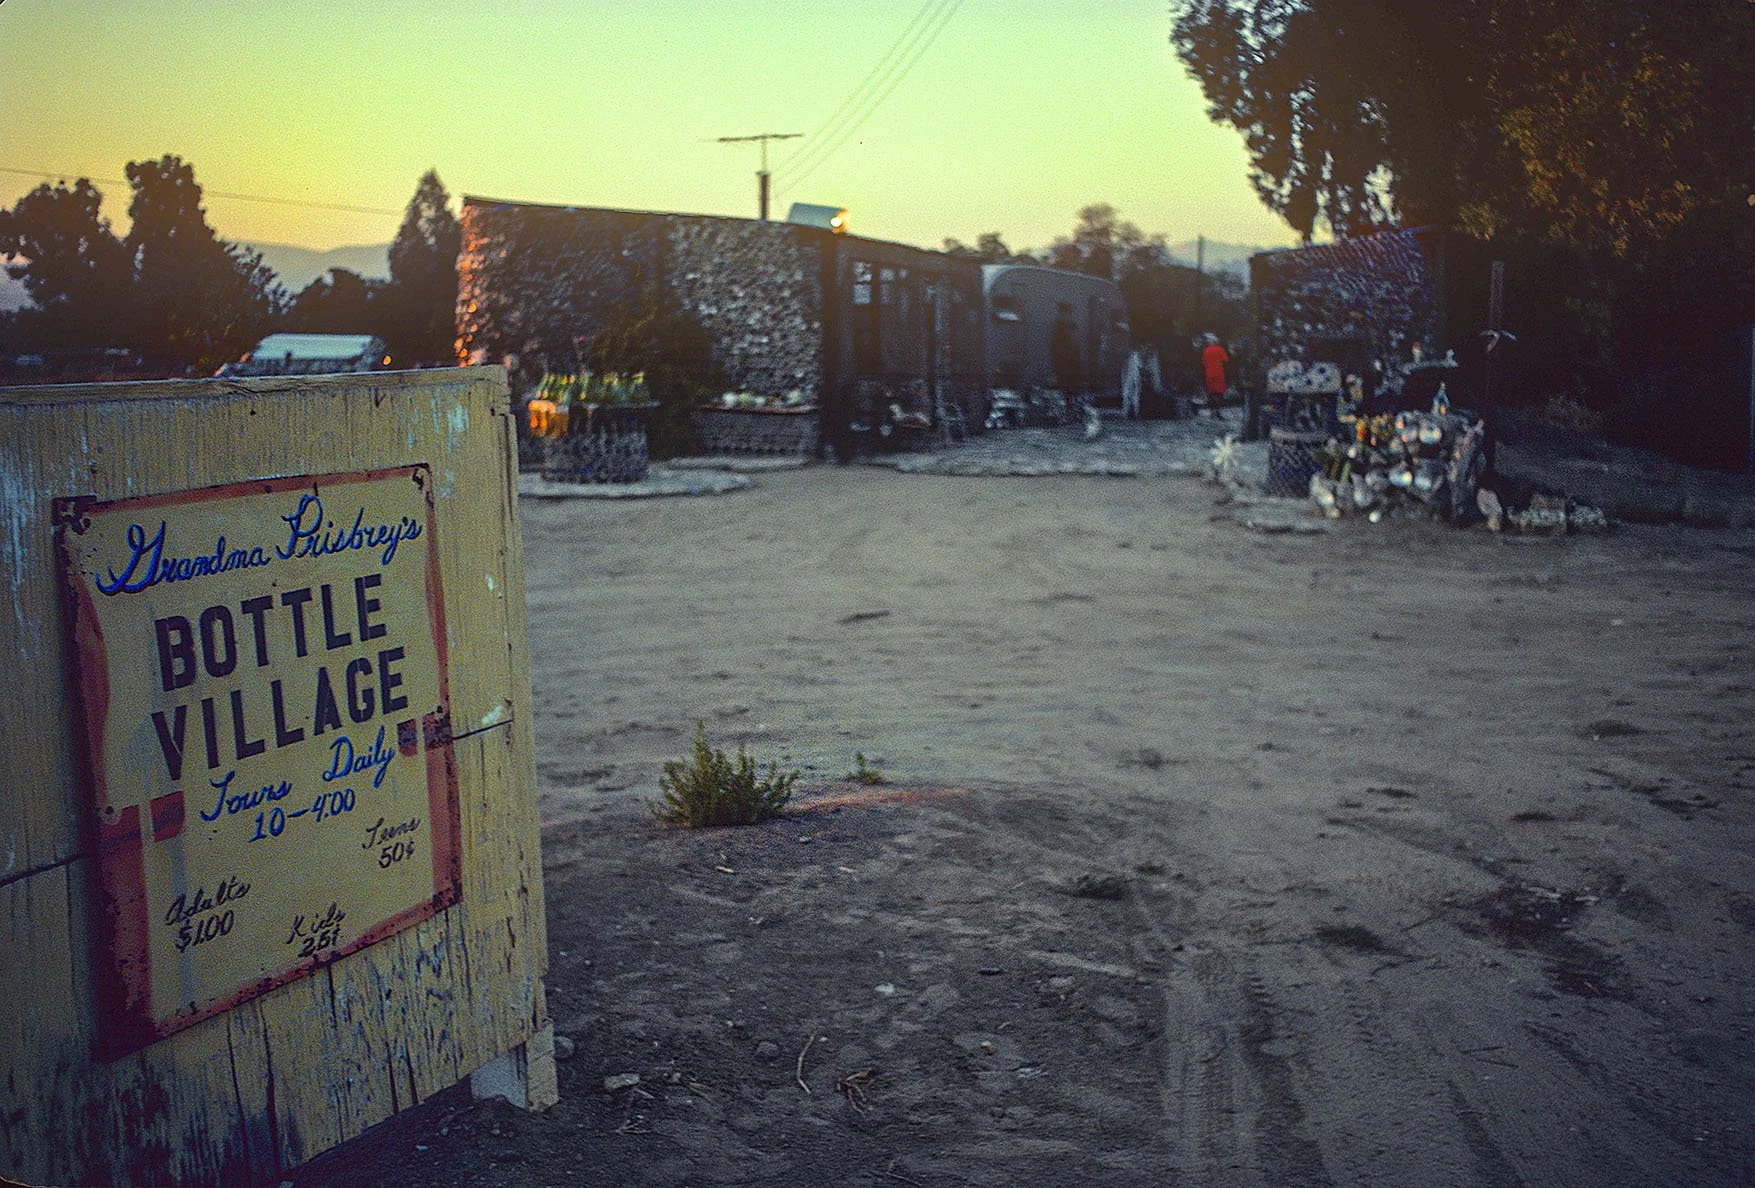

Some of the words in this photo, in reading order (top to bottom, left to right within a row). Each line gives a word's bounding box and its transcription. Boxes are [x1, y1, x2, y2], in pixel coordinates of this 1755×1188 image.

[97, 519, 271, 597] Grandma
[276, 494, 422, 565] Prisbrey's
[155, 573, 387, 692] BOTTLE
[151, 647, 408, 782] VILLAGE
[201, 771, 293, 823] Tours
[322, 725, 396, 789] Daily
[362, 815, 421, 850] Teens
[378, 841, 415, 870] 50¢
[165, 875, 251, 927] Adults
[286, 901, 347, 945] Kids
